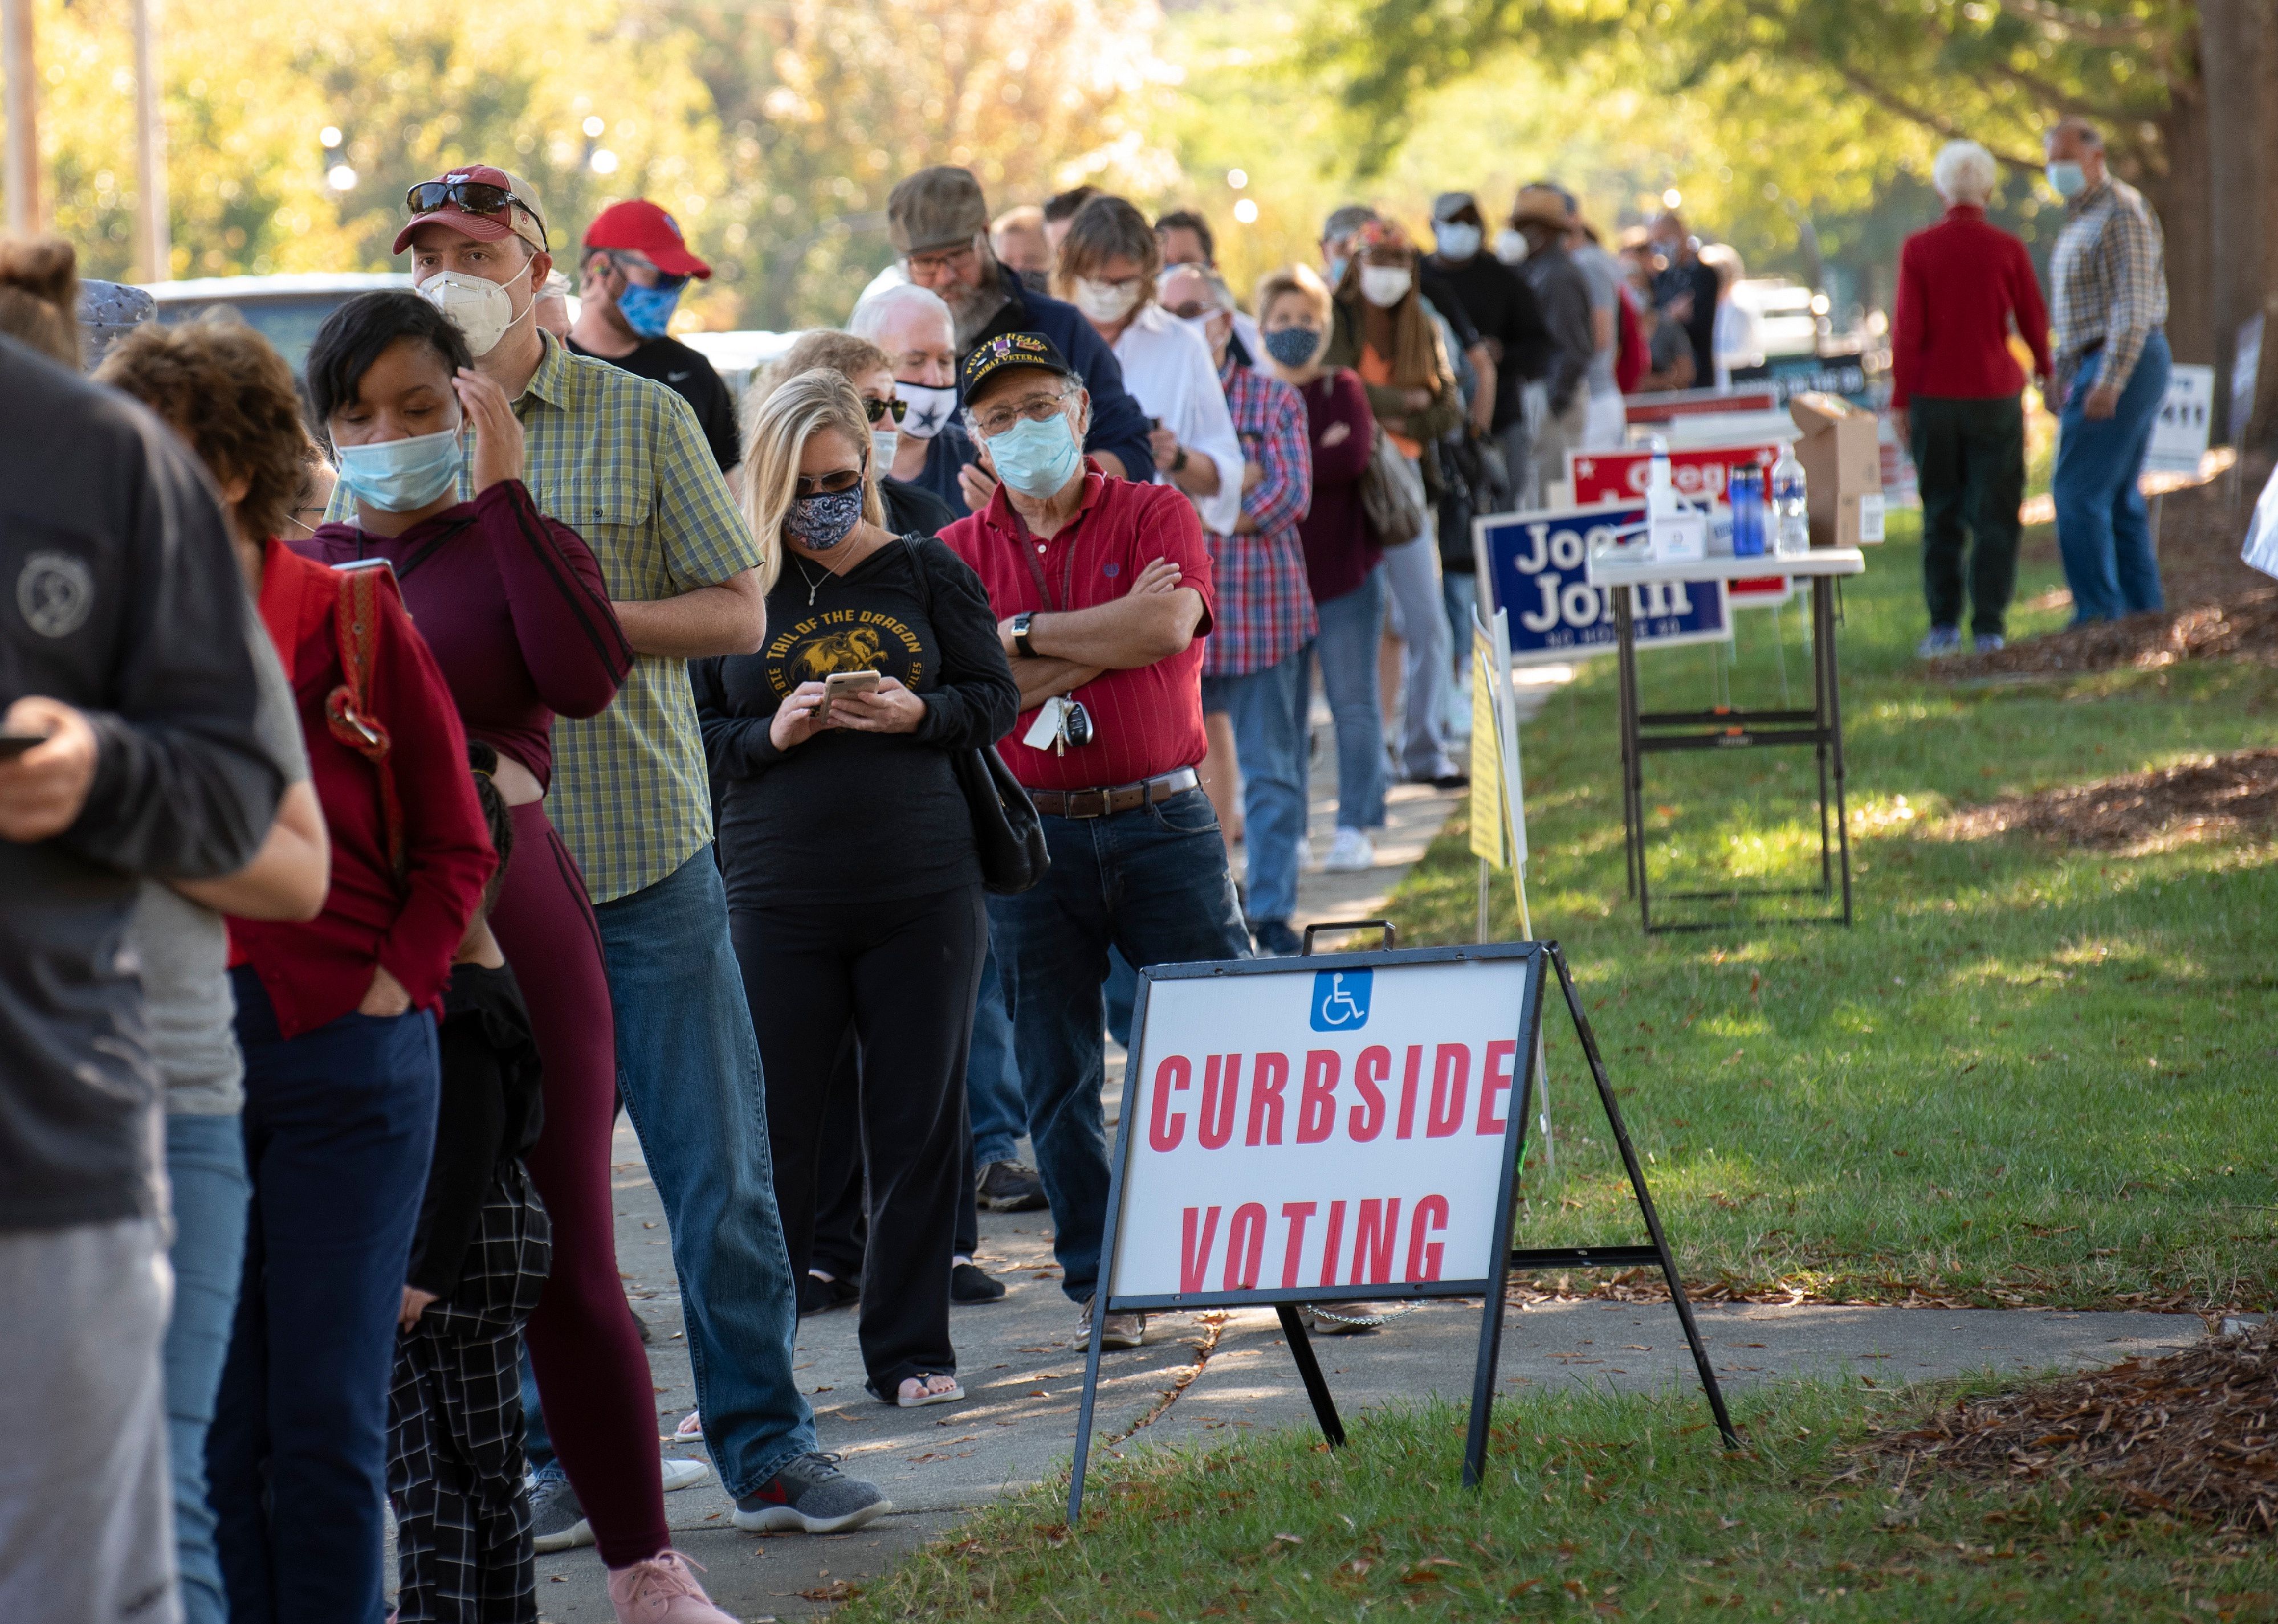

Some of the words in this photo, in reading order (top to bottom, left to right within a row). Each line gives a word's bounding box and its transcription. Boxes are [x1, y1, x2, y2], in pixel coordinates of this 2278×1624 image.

[1003, 353, 1045, 364] VETERAN
[1626, 460, 1726, 496] Geg
[767, 633, 800, 659] TAIL
[795, 617, 818, 634] OF
[820, 609, 855, 625] THE
[858, 610, 923, 654] DRAGON
[1149, 1040, 1517, 1153] CURBSIDE
[1180, 1194, 1450, 1294] VOTING
